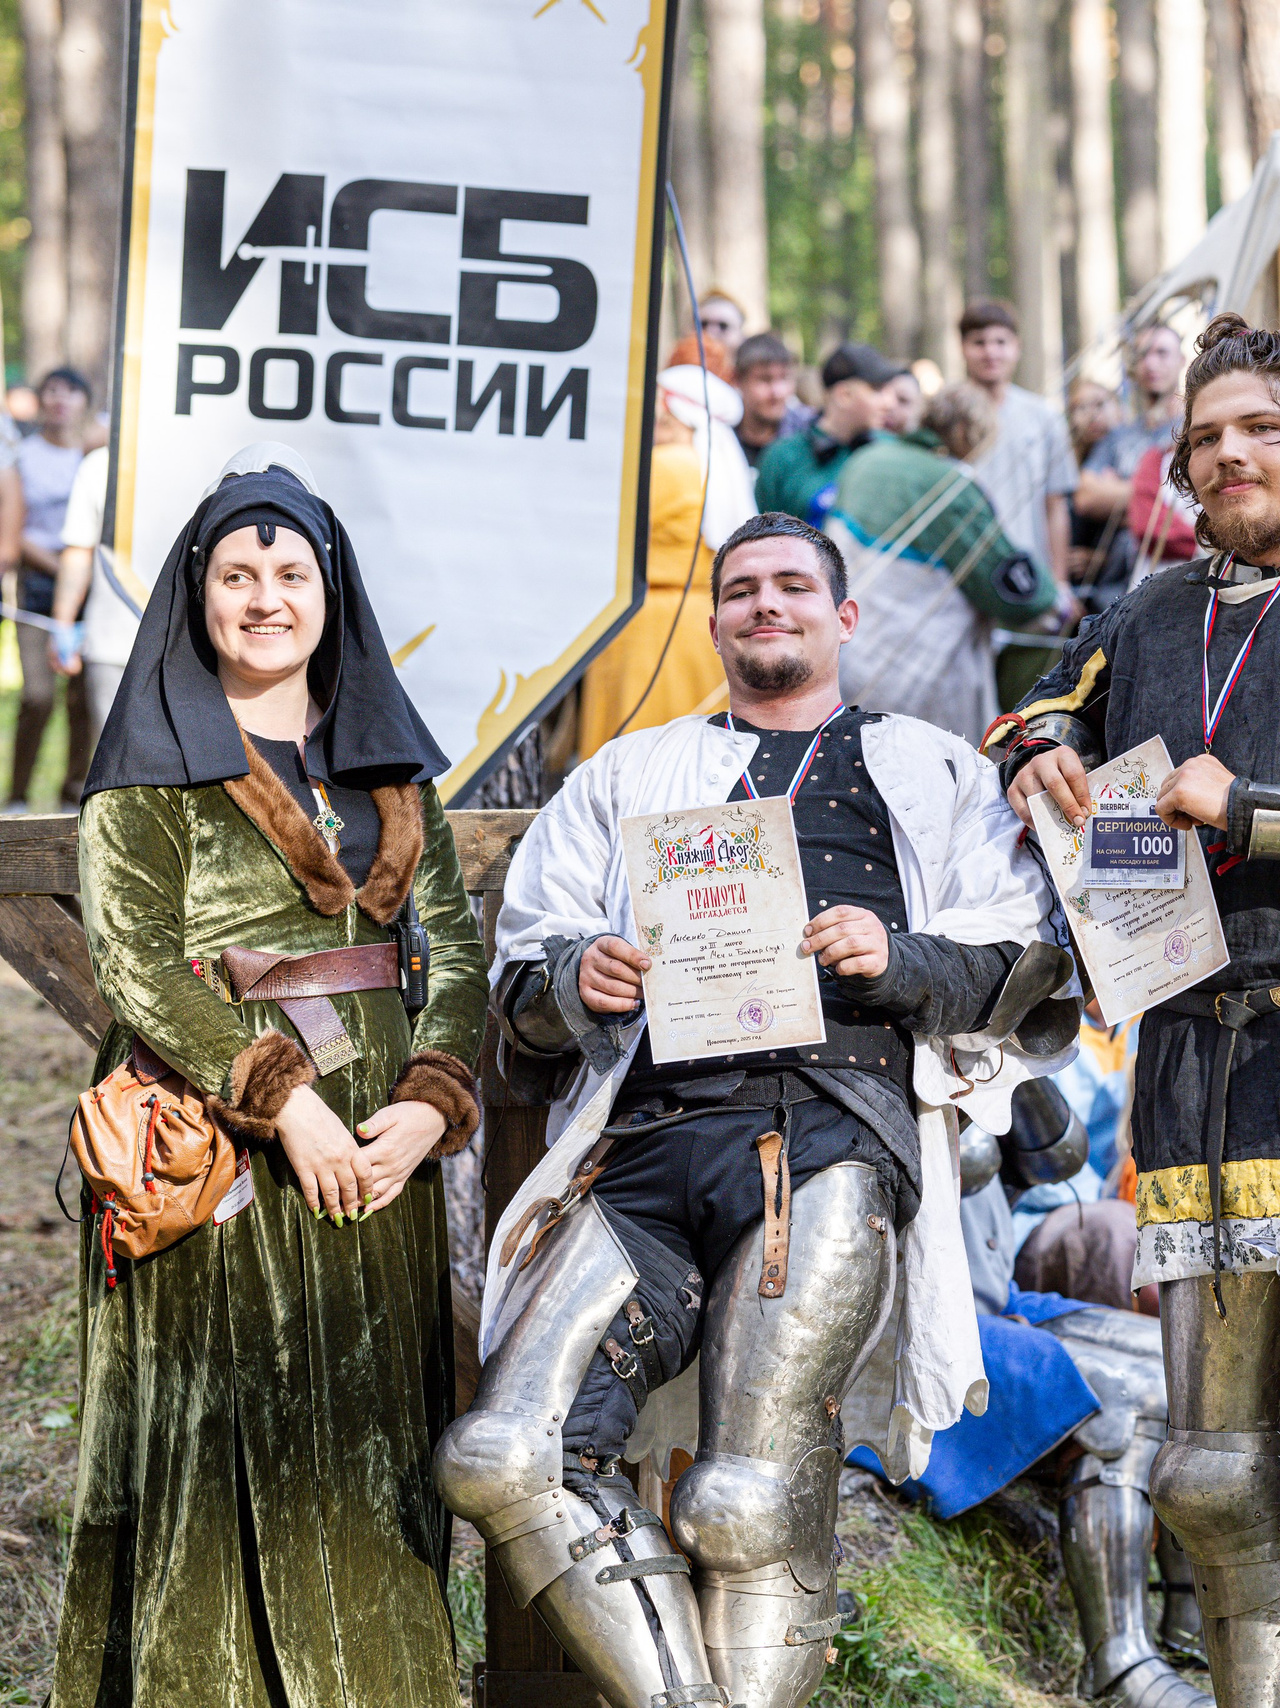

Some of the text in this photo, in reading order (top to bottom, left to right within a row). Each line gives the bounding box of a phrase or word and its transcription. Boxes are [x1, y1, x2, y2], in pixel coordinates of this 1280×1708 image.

[180, 168, 598, 353] ИСБ
[175, 343, 589, 440] РОССИИ
[667, 839, 749, 866] Княжий Двор
[1132, 836, 1173, 855] 1000
[687, 883, 747, 911] ГРАМОТА
[689, 906, 748, 920] НАГРАЖДАЕТСЯ
